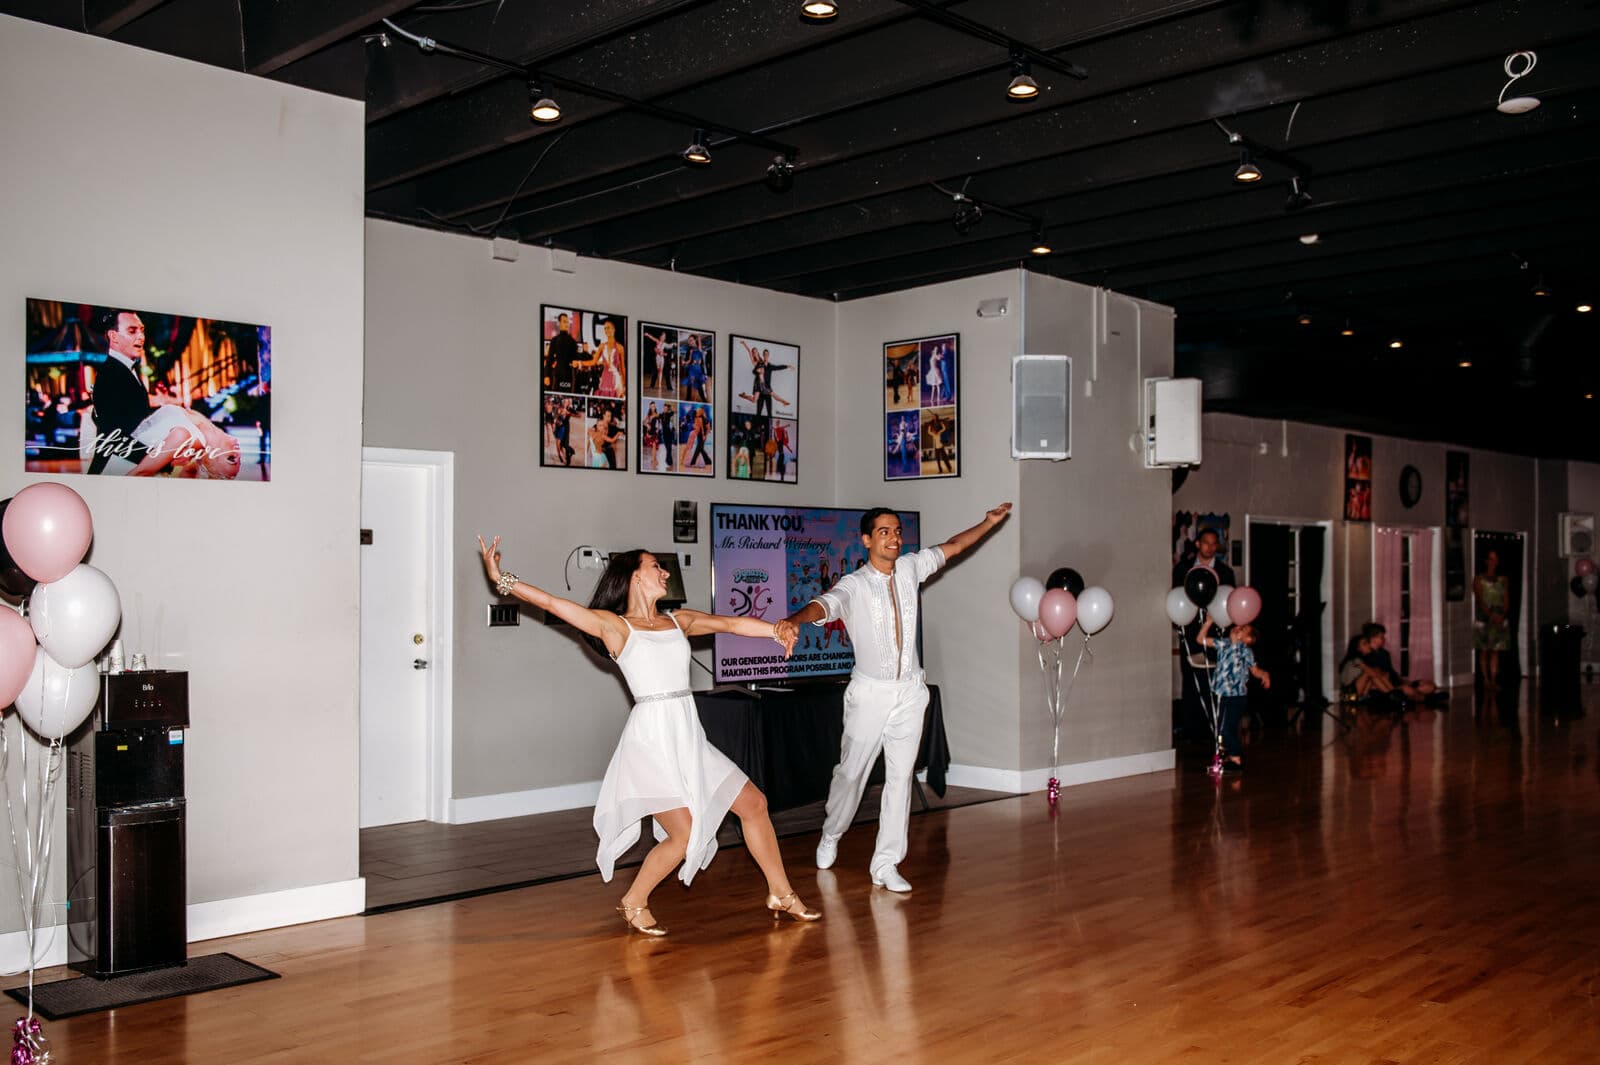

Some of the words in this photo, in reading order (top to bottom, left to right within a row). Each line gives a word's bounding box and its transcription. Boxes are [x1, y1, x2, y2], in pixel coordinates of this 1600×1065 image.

[83, 429, 137, 460] this
[173, 436, 226, 460] love
[716, 512, 769, 531] THANK
[771, 514, 805, 534] YOU,
[715, 535, 735, 549] Mr.
[738, 535, 782, 550] Richard
[721, 657, 738, 667] OUR
[738, 655, 778, 666] GENEROUS
[808, 652, 821, 662] ARE
[721, 668, 752, 678] MAKING
[752, 667, 769, 676] THIS
[769, 664, 805, 675] PROGRAM
[805, 662, 837, 673] POSSIBLE
[837, 661, 851, 670] AND
